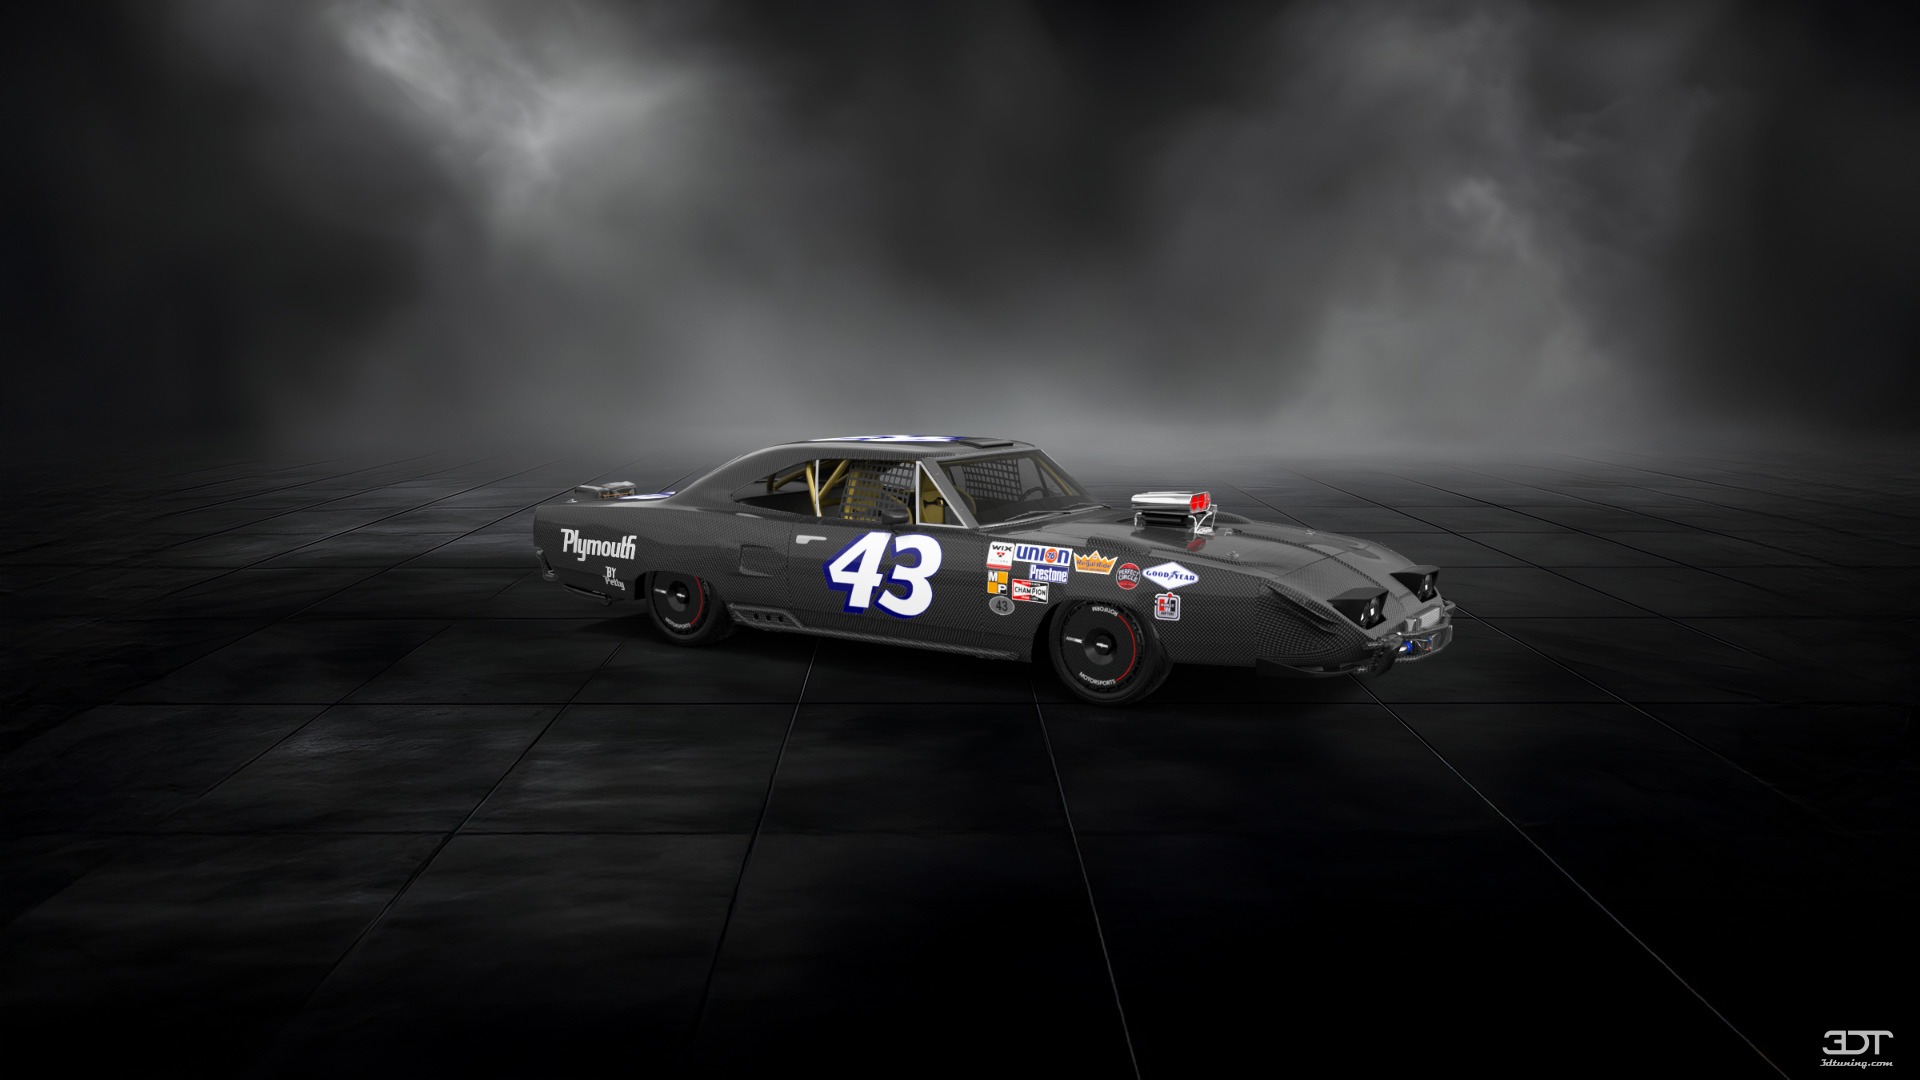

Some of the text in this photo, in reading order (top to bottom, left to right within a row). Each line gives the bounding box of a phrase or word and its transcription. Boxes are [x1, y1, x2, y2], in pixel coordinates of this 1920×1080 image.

[560, 528, 637, 562] Plymouth
[992, 544, 1012, 552] WIX
[605, 565, 616, 579] BY
[822, 532, 942, 619] 43
[1030, 564, 1068, 583] Prestone
[1118, 569, 1139, 577] PERFECT
[1118, 574, 1138, 583] CIRCLE
[1014, 586, 1046, 596] CHAMPION
[995, 600, 1009, 612] 43
